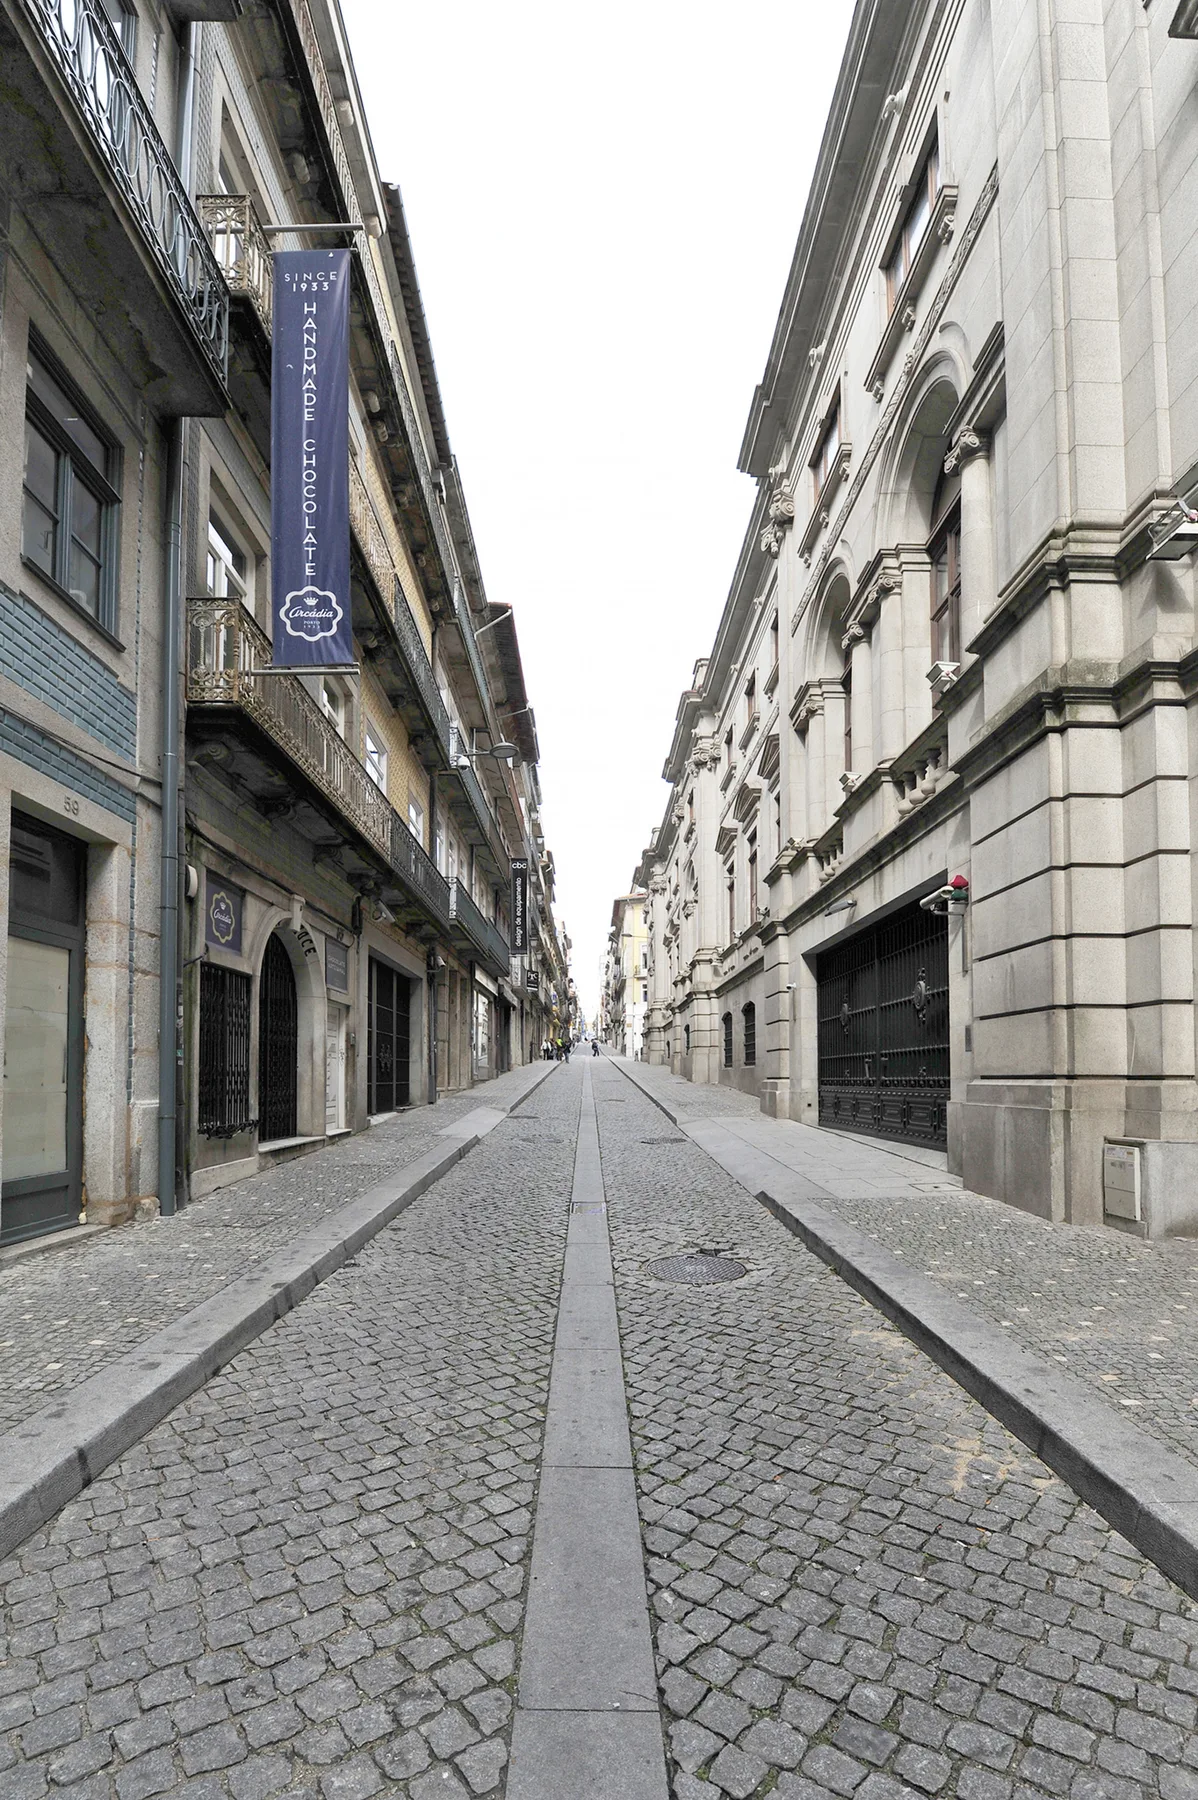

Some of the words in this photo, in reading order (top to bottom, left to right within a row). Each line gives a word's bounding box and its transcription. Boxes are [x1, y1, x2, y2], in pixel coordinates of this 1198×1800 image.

[284, 271, 338, 282] SINCE
[292, 282, 330, 292] 1933
[302, 302, 317, 421] HANDMADE
[302, 438, 318, 576] CHOCOLATE
[289, 605, 334, 618] Arcádia
[64, 796, 79, 816] 59
[515, 917, 522, 926] de
[515, 926, 523, 947] design
